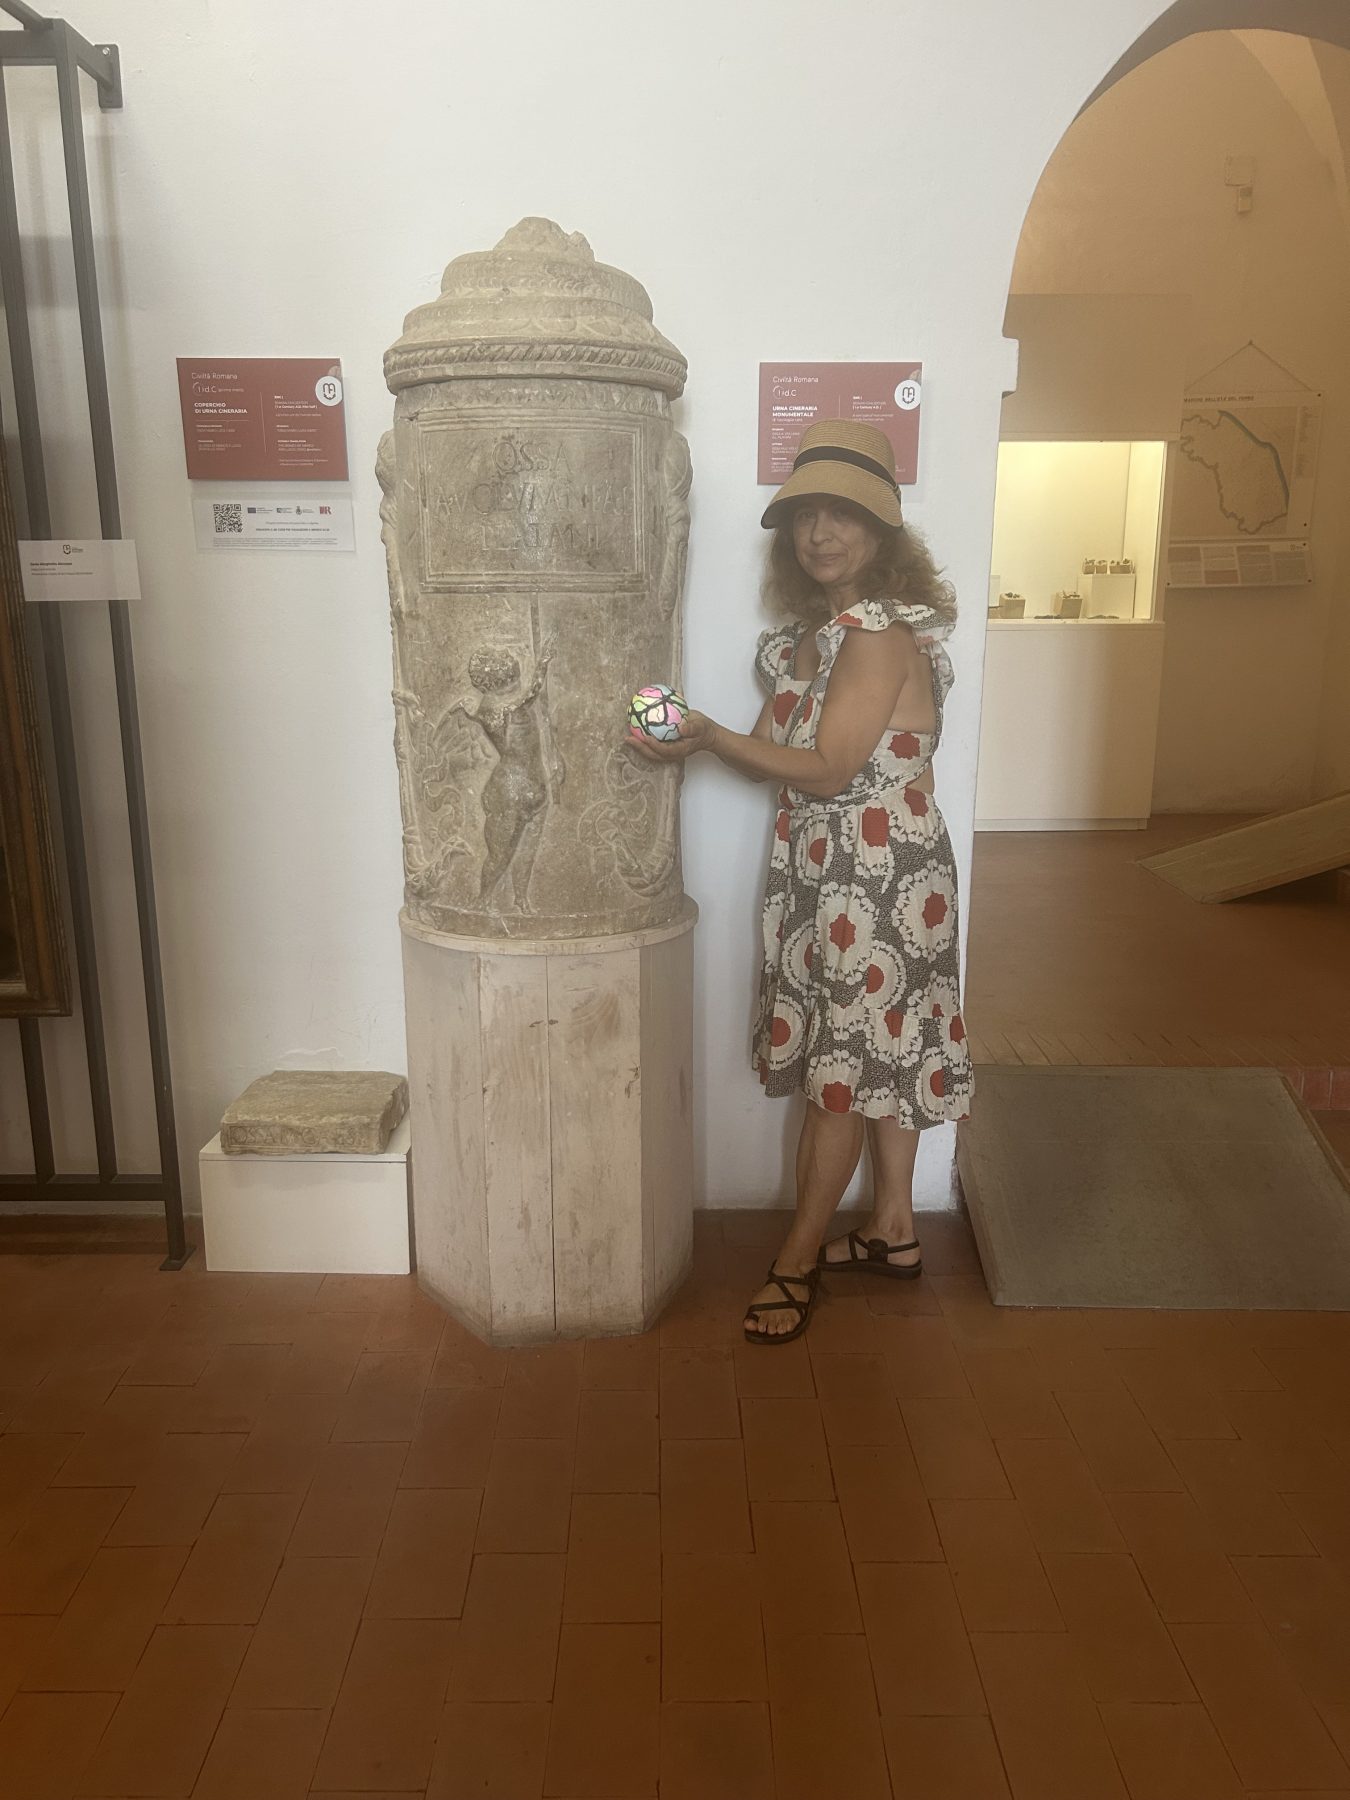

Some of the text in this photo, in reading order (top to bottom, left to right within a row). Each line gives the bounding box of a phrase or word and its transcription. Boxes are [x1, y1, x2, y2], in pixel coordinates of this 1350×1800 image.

[212, 372, 238, 380] Romana
[793, 375, 819, 383] Romana
[493, 439, 574, 473] OSSA
